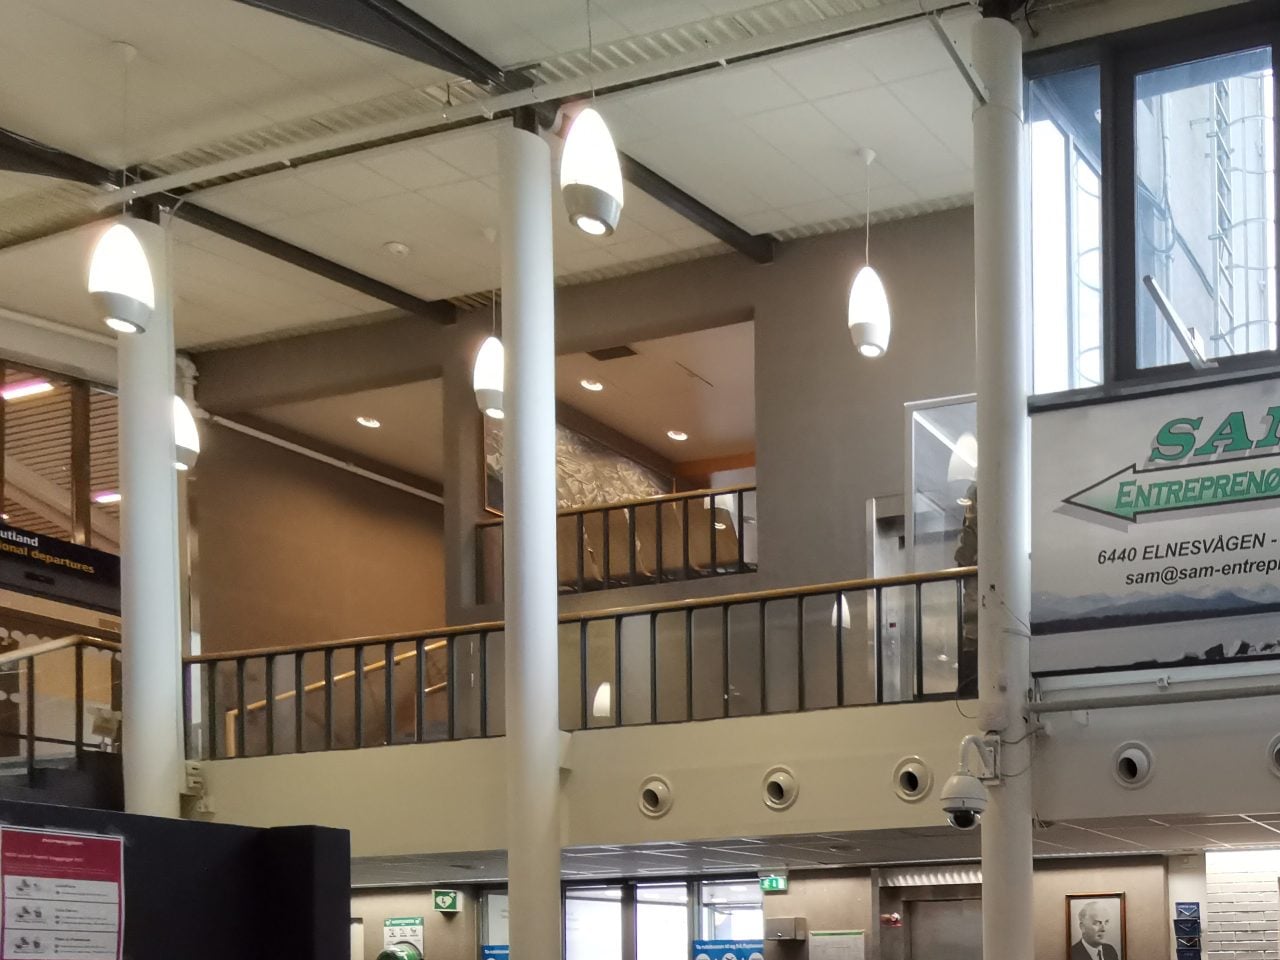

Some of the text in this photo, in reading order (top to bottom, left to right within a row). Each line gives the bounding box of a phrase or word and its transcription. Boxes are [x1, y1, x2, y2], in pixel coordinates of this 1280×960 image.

[31, 549, 95, 574] departures
[1097, 547, 1137, 565] 6440
[1142, 534, 1266, 560] ELNESVÅGEN
